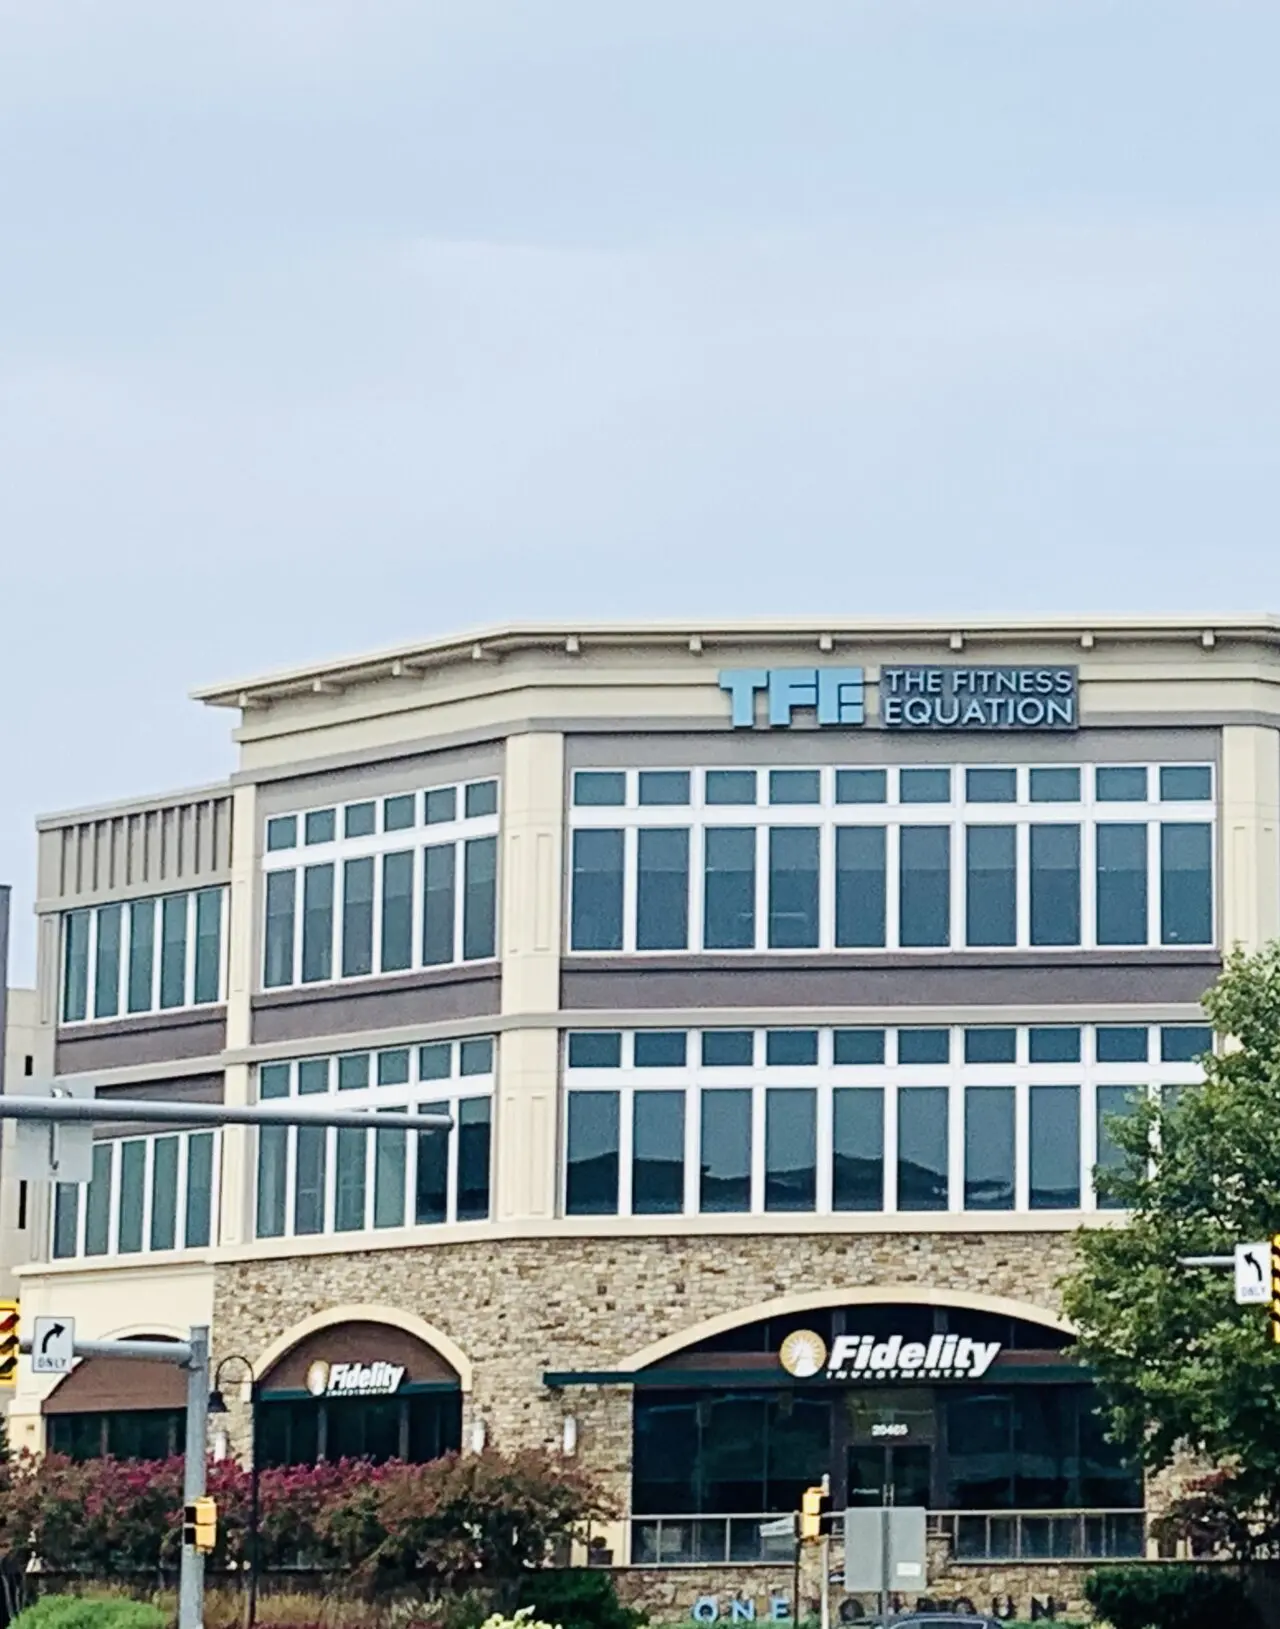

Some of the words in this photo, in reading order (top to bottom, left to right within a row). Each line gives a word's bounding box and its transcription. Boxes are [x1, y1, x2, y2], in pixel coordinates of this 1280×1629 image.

[886, 670, 941, 692] THE
[952, 670, 1072, 693] FITNESS
[885, 698, 1073, 725] EQUATION
[38, 1357, 66, 1368] ONLY
[828, 1334, 1002, 1378] Fidelity
[328, 1361, 405, 1394] Fidelity
[693, 1595, 792, 1623] ONE
